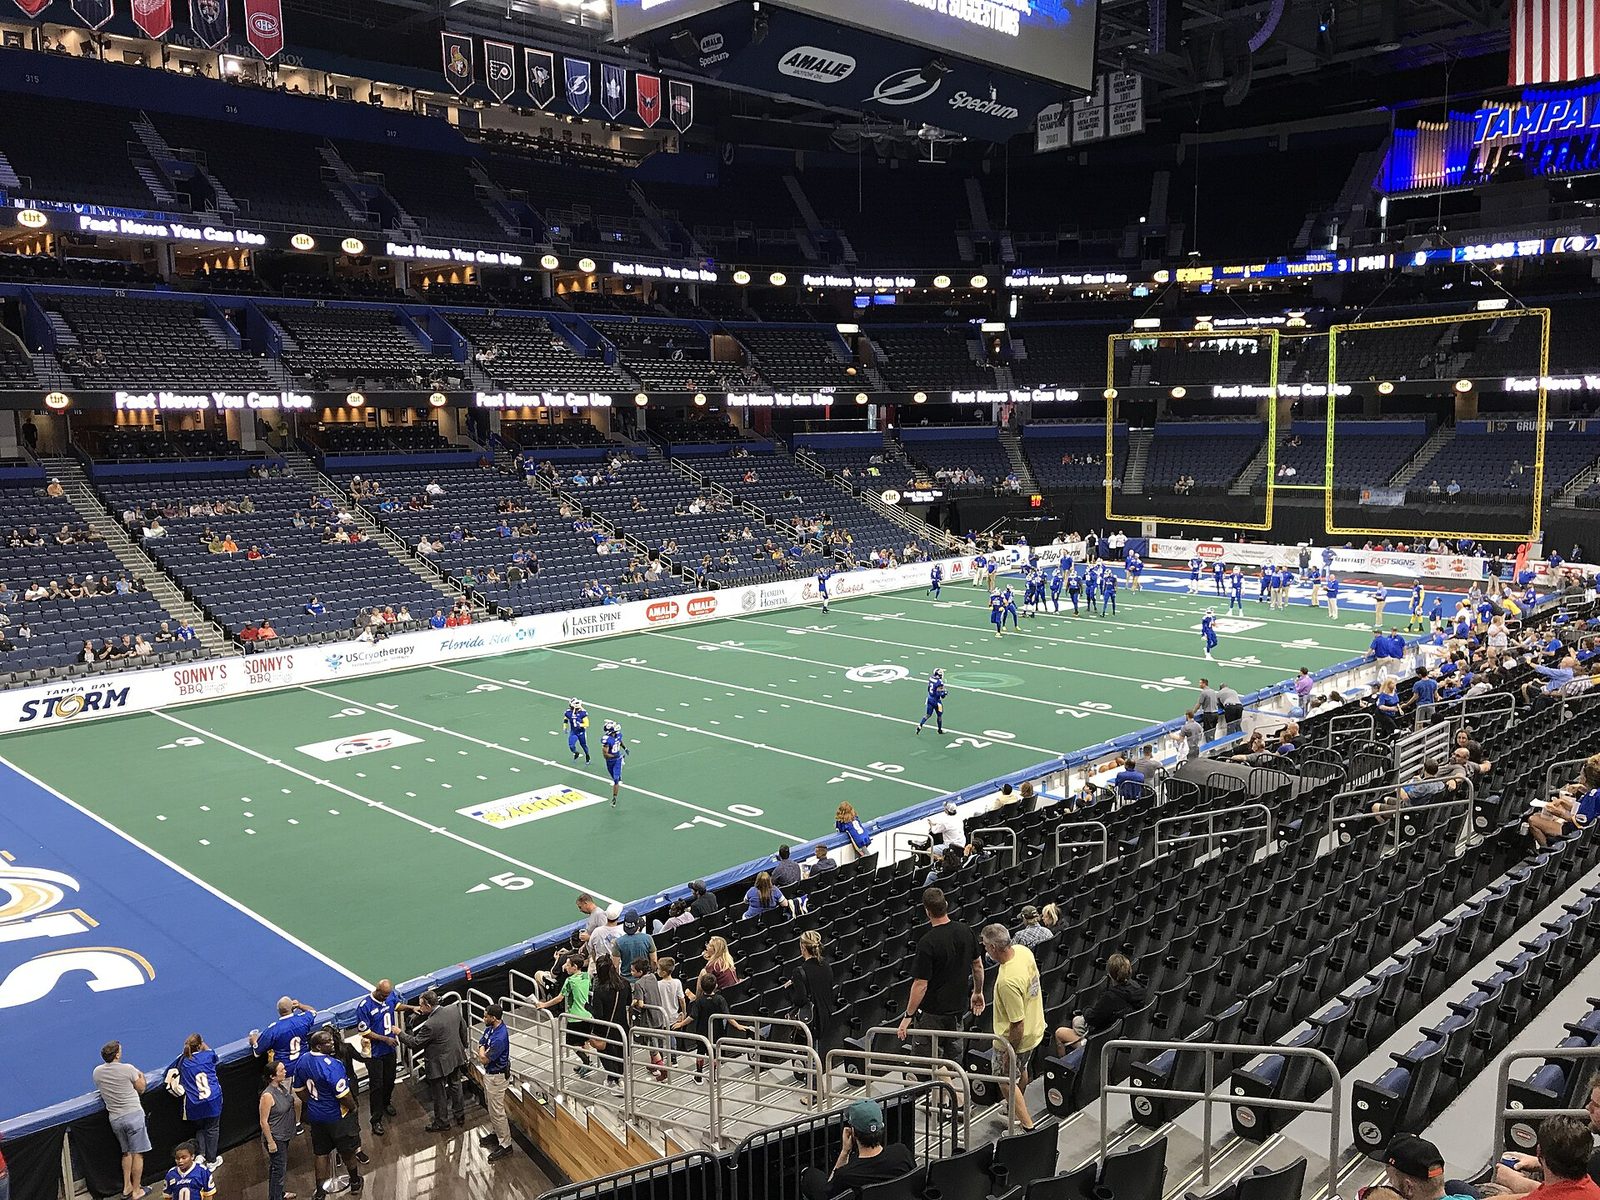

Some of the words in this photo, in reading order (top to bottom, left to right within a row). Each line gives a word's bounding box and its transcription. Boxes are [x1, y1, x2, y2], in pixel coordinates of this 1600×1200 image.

[949, 0, 1020, 37] SUGGESTIONS
[702, 36, 723, 48] AMALIE
[784, 53, 851, 77] AMALIE
[25, 74, 40, 84] 315
[225, 105, 238, 114] 316
[949, 91, 1019, 119] Spectrum
[1474, 96, 1587, 145] TAMPA
[23, 213, 41, 222] tbt
[80, 215, 118, 233] Fast
[121, 219, 168, 236] News
[170, 223, 201, 240] You
[203, 227, 234, 242] Can
[236, 230, 265, 244] Use
[296, 236, 310, 245] tbt
[346, 241, 359, 249] tbt
[387, 242, 414, 257] Fast
[416, 246, 450, 260] News
[452, 248, 474, 262] You
[476, 250, 498, 264] Can
[500, 252, 522, 265] Use
[1287, 262, 1333, 273] TIMEOUTS
[1338, 259, 1347, 271] 3
[1358, 255, 1385, 271] PHI
[613, 262, 634, 274] Fast
[635, 264, 661, 277] News
[663, 266, 680, 278] You
[682, 267, 699, 280] Can
[700, 269, 717, 281] Use
[803, 275, 824, 286] Fast
[826, 276, 852, 287] News
[854, 277, 872, 287] You
[873, 276, 894, 287] Can
[895, 277, 915, 287] Use
[1005, 276, 1028, 286] Fast
[1030, 275, 1059, 286] News
[1061, 274, 1081, 284] You
[1083, 274, 1104, 283] Can
[1106, 273, 1127, 283] Use
[1213, 385, 1240, 397] Fast
[1278, 384, 1300, 396] You
[1302, 384, 1326, 396] Can
[1505, 377, 1537, 391] Fast
[1539, 376, 1581, 390] News
[50, 395, 64, 404] tbt
[115, 392, 156, 409] Fast
[159, 392, 209, 408] News
[212, 392, 244, 408] You
[246, 391, 278, 408] Can
[281, 392, 312, 408] Use
[476, 392, 504, 407] Fast
[505, 392, 540, 407] News
[541, 392, 565, 407] You
[565, 392, 588, 407] Can
[589, 392, 612, 407] Use
[727, 393, 748, 406] Fast
[748, 393, 773, 406] News
[775, 393, 791, 406] You
[792, 393, 811, 406] Can
[813, 392, 833, 405] Use
[952, 391, 975, 403] Fast
[977, 391, 1008, 402] News
[1009, 390, 1030, 402] You
[1032, 389, 1054, 401] Can
[1056, 389, 1078, 401] Use
[1568, 421, 1577, 431] 7
[1370, 556, 1415, 567] FASTSIGNS
[687, 599, 716, 612] AMALIE
[760, 597, 789, 608] HOSPITAL
[648, 603, 679, 617] AMALIE
[572, 616, 598, 626] LASER
[599, 612, 622, 624] SPINE
[572, 623, 616, 636] INSTITUTE
[440, 638, 485, 652] Florida
[345, 645, 415, 663] USCryotherapy
[245, 654, 294, 675] SONNY'S
[174, 664, 227, 686] SONNY'S
[249, 672, 272, 684] BBQ
[47, 686, 84, 696] TAMPA
[91, 682, 113, 690] BAY
[179, 683, 203, 696] BBQ
[19, 687, 130, 722] STORM
[1055, 700, 1113, 719] 25
[955, 729, 1016, 749] 20
[840, 761, 905, 782] 15
[690, 803, 764, 829] 10
[488, 872, 534, 891] 5
[384, 1012, 392, 1035] 9
[195, 1072, 212, 1100] 9
